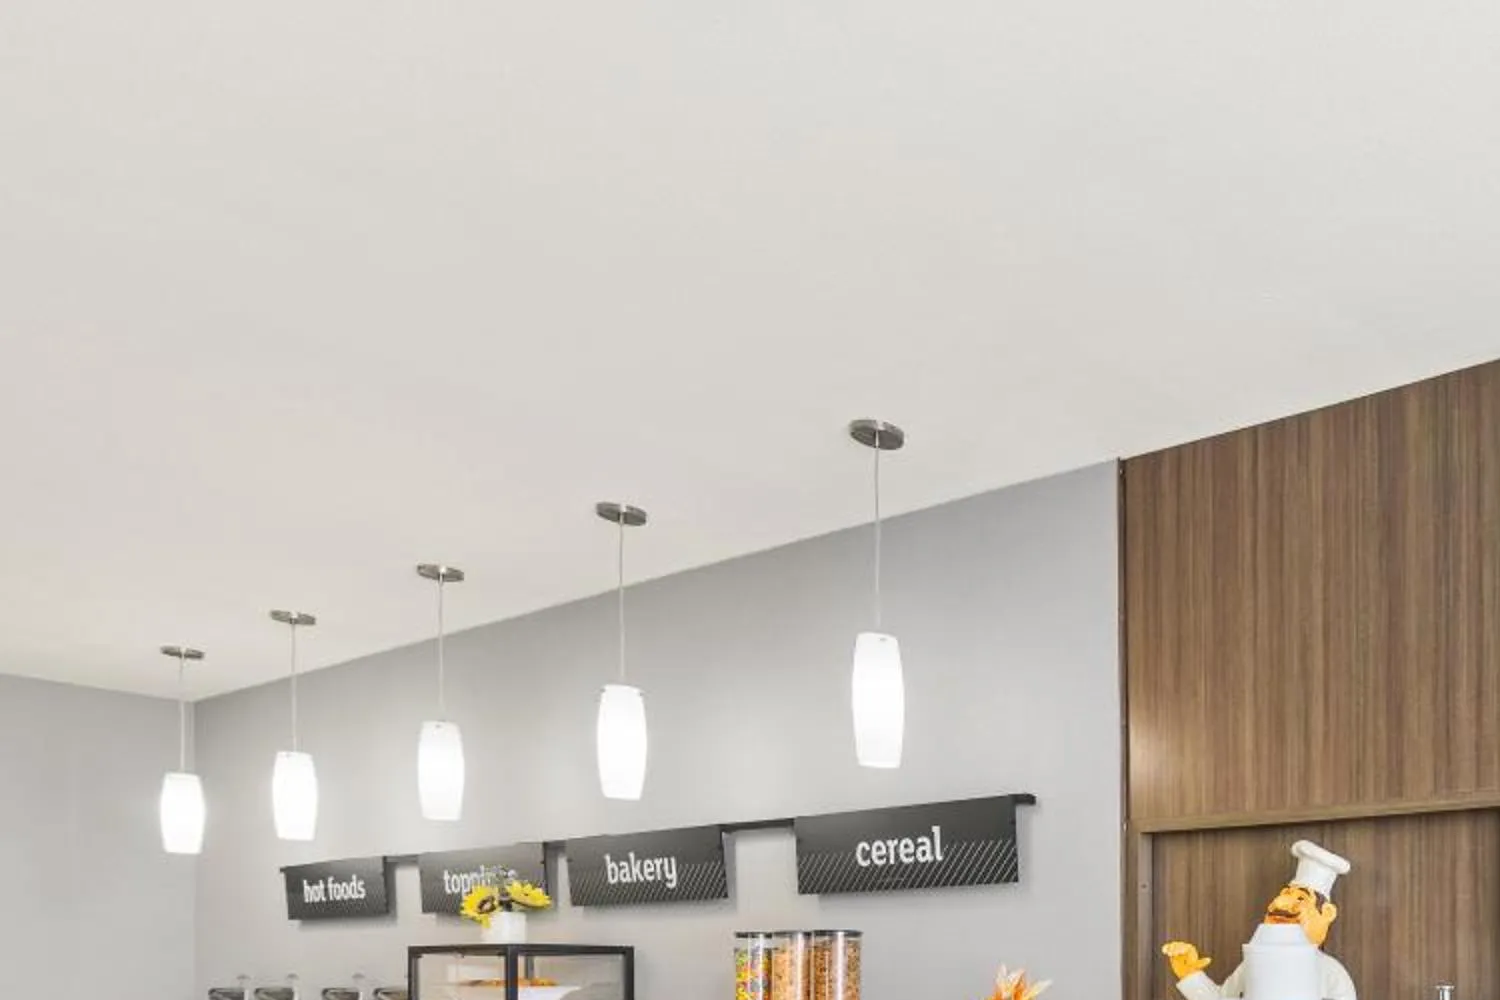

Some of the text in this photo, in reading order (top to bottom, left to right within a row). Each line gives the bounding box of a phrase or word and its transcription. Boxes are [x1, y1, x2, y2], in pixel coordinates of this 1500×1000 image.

[856, 825, 944, 867] cereal
[303, 873, 366, 903] hot foods
[444, 865, 517, 899] topis
[604, 851, 677, 889] bakery
